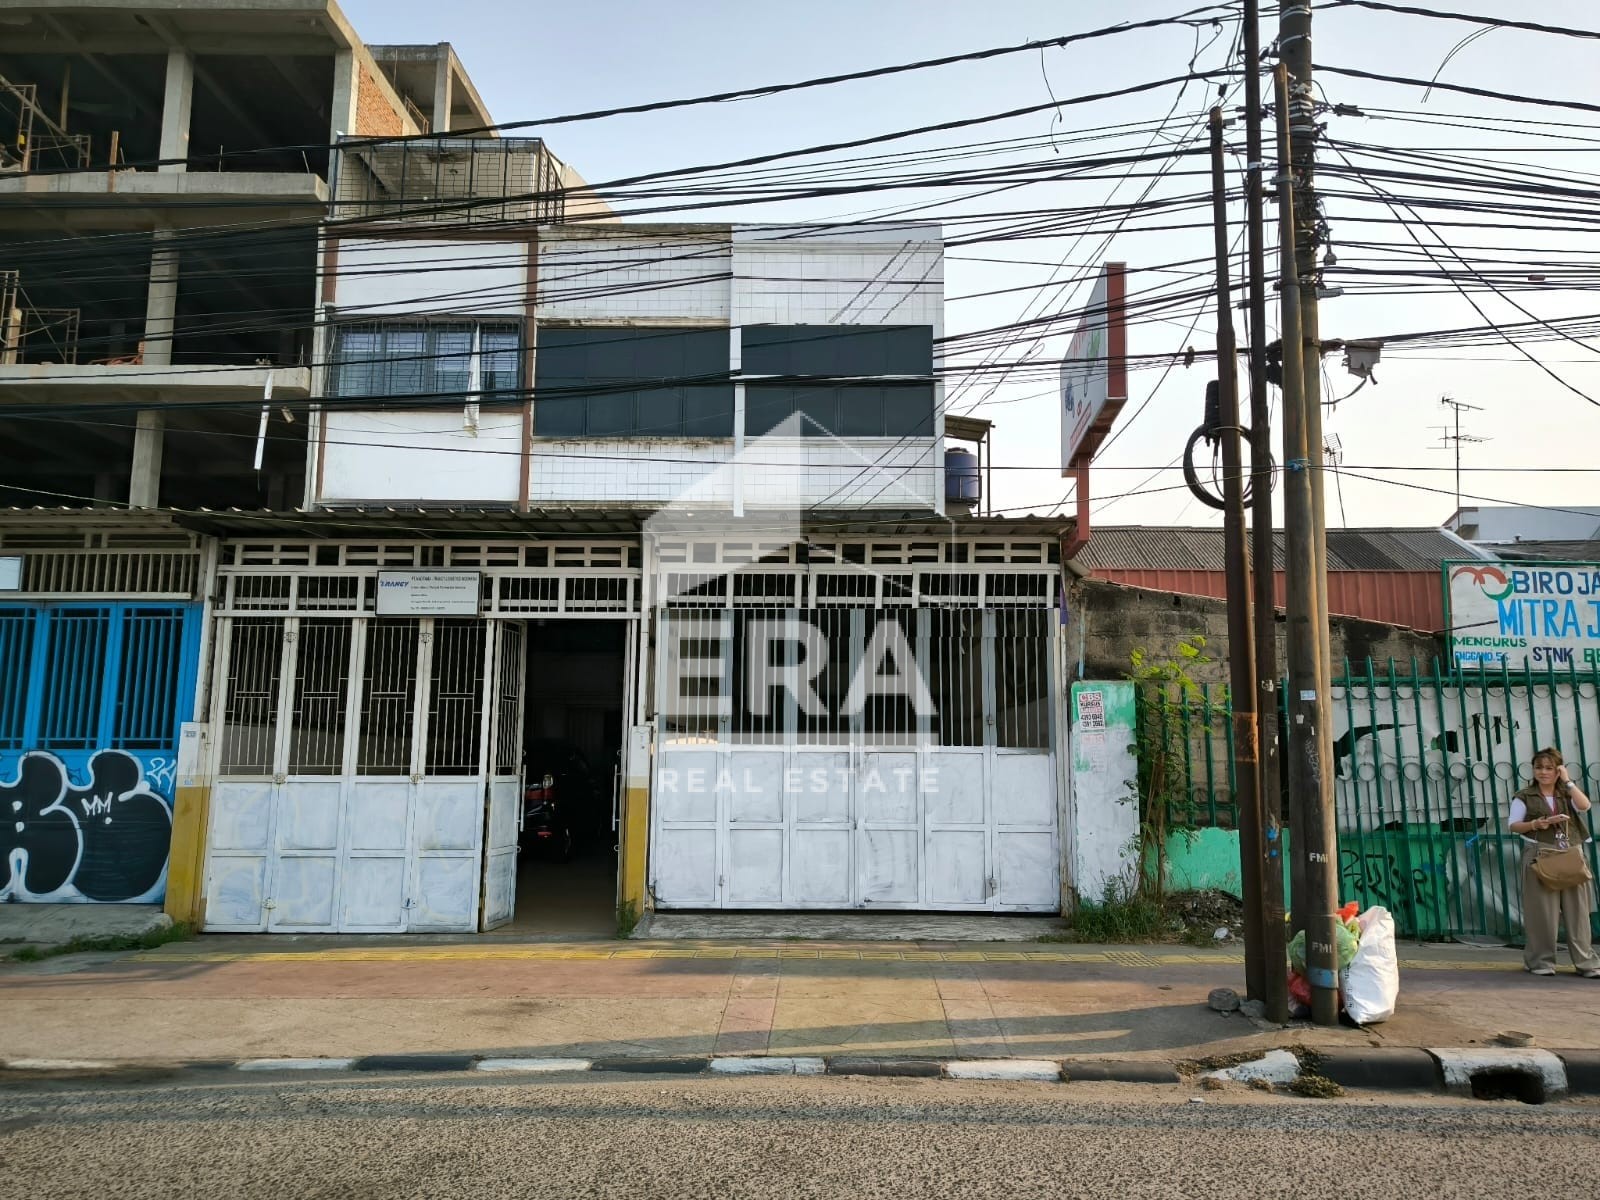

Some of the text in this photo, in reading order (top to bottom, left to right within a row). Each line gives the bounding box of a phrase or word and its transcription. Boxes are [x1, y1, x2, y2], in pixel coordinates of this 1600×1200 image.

[1512, 570, 1573, 595] BIRO
[1498, 599, 1581, 637] MITRA
[1453, 636, 1527, 648] MENGURUS
[1533, 647, 1574, 663] STNK
